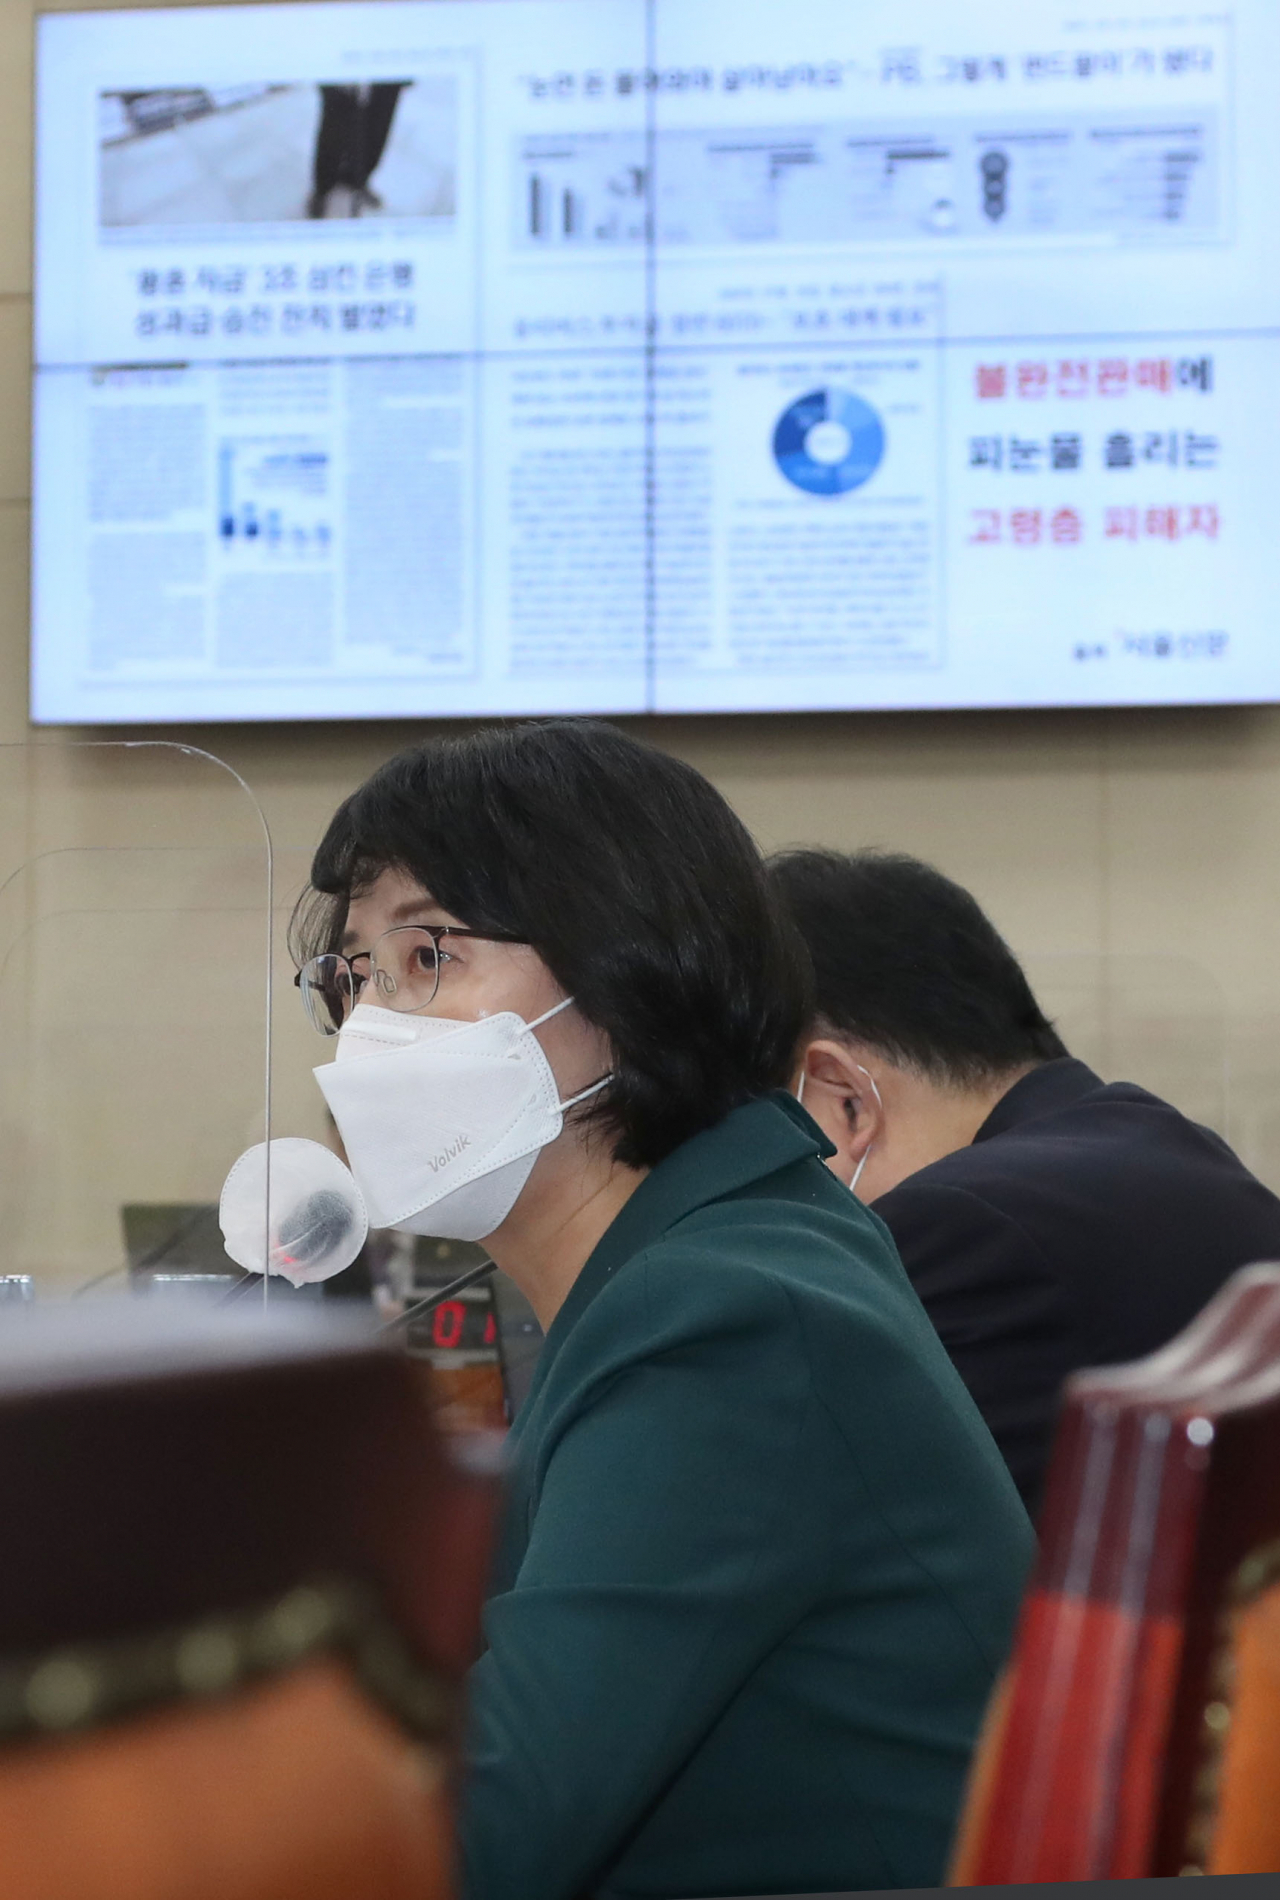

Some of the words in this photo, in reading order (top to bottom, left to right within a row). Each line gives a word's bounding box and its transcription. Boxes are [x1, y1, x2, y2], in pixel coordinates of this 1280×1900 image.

[974, 356, 1214, 400] 불완전판매에
[968, 432, 1083, 472] 피눈물
[1105, 430, 1220, 472] 흘리는
[1104, 504, 1221, 542] 피해자
[427, 1135, 472, 1173] Volvik
